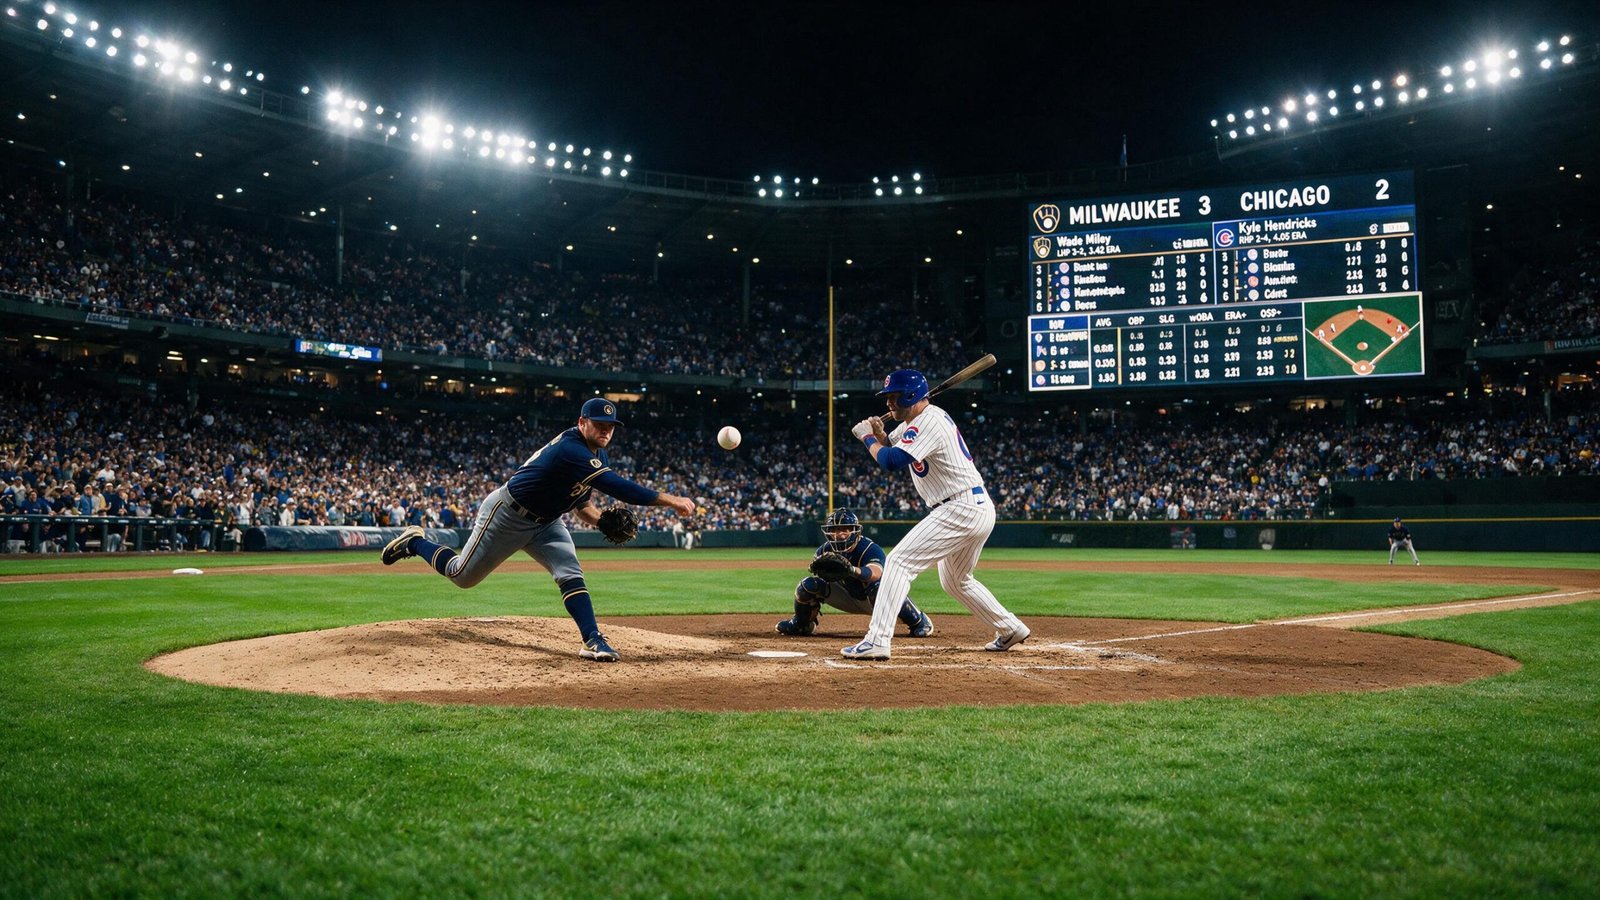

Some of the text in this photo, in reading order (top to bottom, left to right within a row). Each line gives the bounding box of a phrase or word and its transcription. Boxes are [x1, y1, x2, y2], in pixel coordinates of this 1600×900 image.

[1240, 179, 1390, 211] CHICAGO 2
[1069, 195, 1211, 225] MILWAUKEE 3
[1238, 216, 1317, 235] Kyle Hendricks
[1056, 233, 1111, 247] Wade Miley
[1239, 230, 1307, 245] RHP 2-4, 4.05 ERA
[1056, 244, 1121, 257] LHP 3-2, 3.42 ERA
[1222, 291, 1229, 301] 6
[1128, 315, 1145, 325] OBP
[1159, 314, 1175, 324] SLG
[1189, 312, 1214, 322] wOBA
[1225, 310, 1247, 320] ERA+
[1095, 317, 1112, 327] AVG
